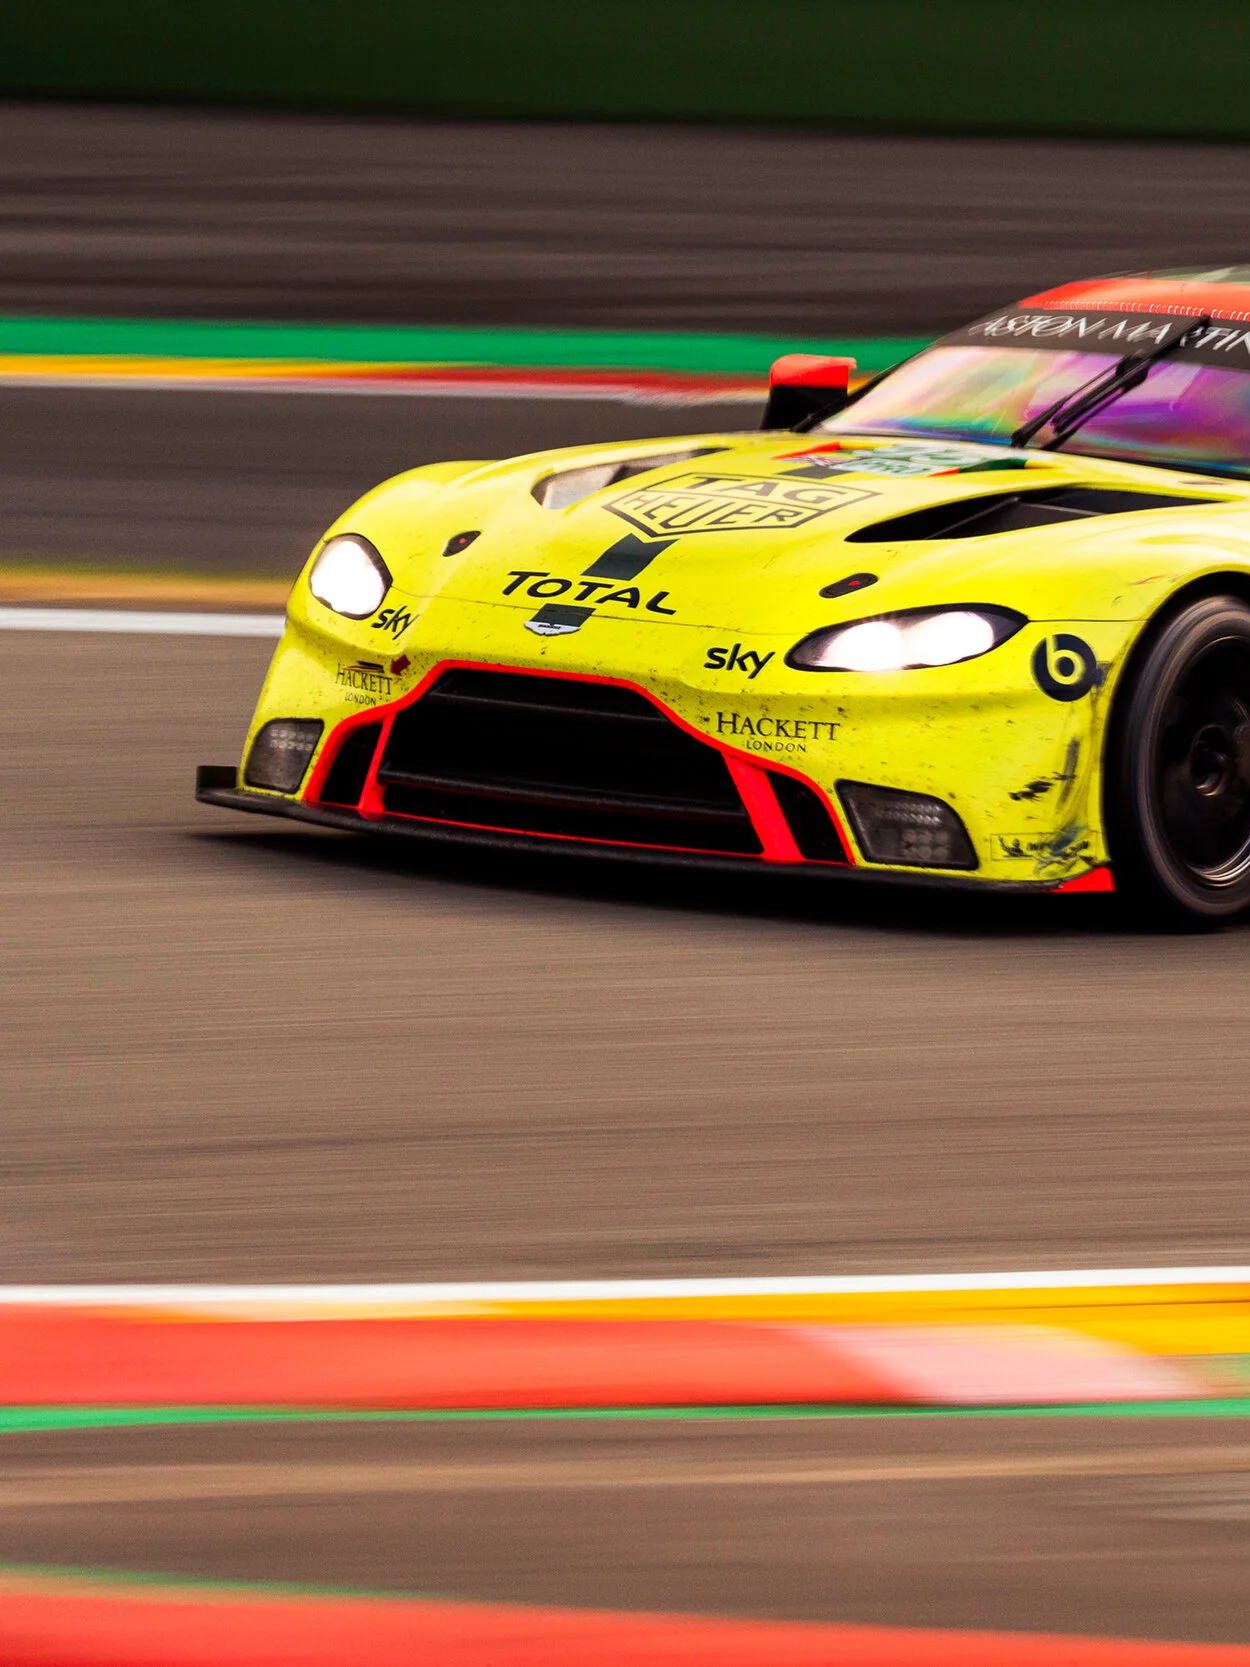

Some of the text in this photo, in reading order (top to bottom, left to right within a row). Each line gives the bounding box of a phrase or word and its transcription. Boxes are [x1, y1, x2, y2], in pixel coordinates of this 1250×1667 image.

[969, 314, 1107, 339] ASTON
[687, 476, 846, 505] TAG
[623, 494, 803, 530] HEUER
[502, 571, 677, 616] TOTAL
[371, 605, 421, 641] sky
[703, 643, 776, 680] sky
[335, 662, 393, 695] HACKETT
[344, 692, 377, 706] LONDON
[716, 711, 841, 741] HACKETT
[746, 739, 807, 752] LONDON
